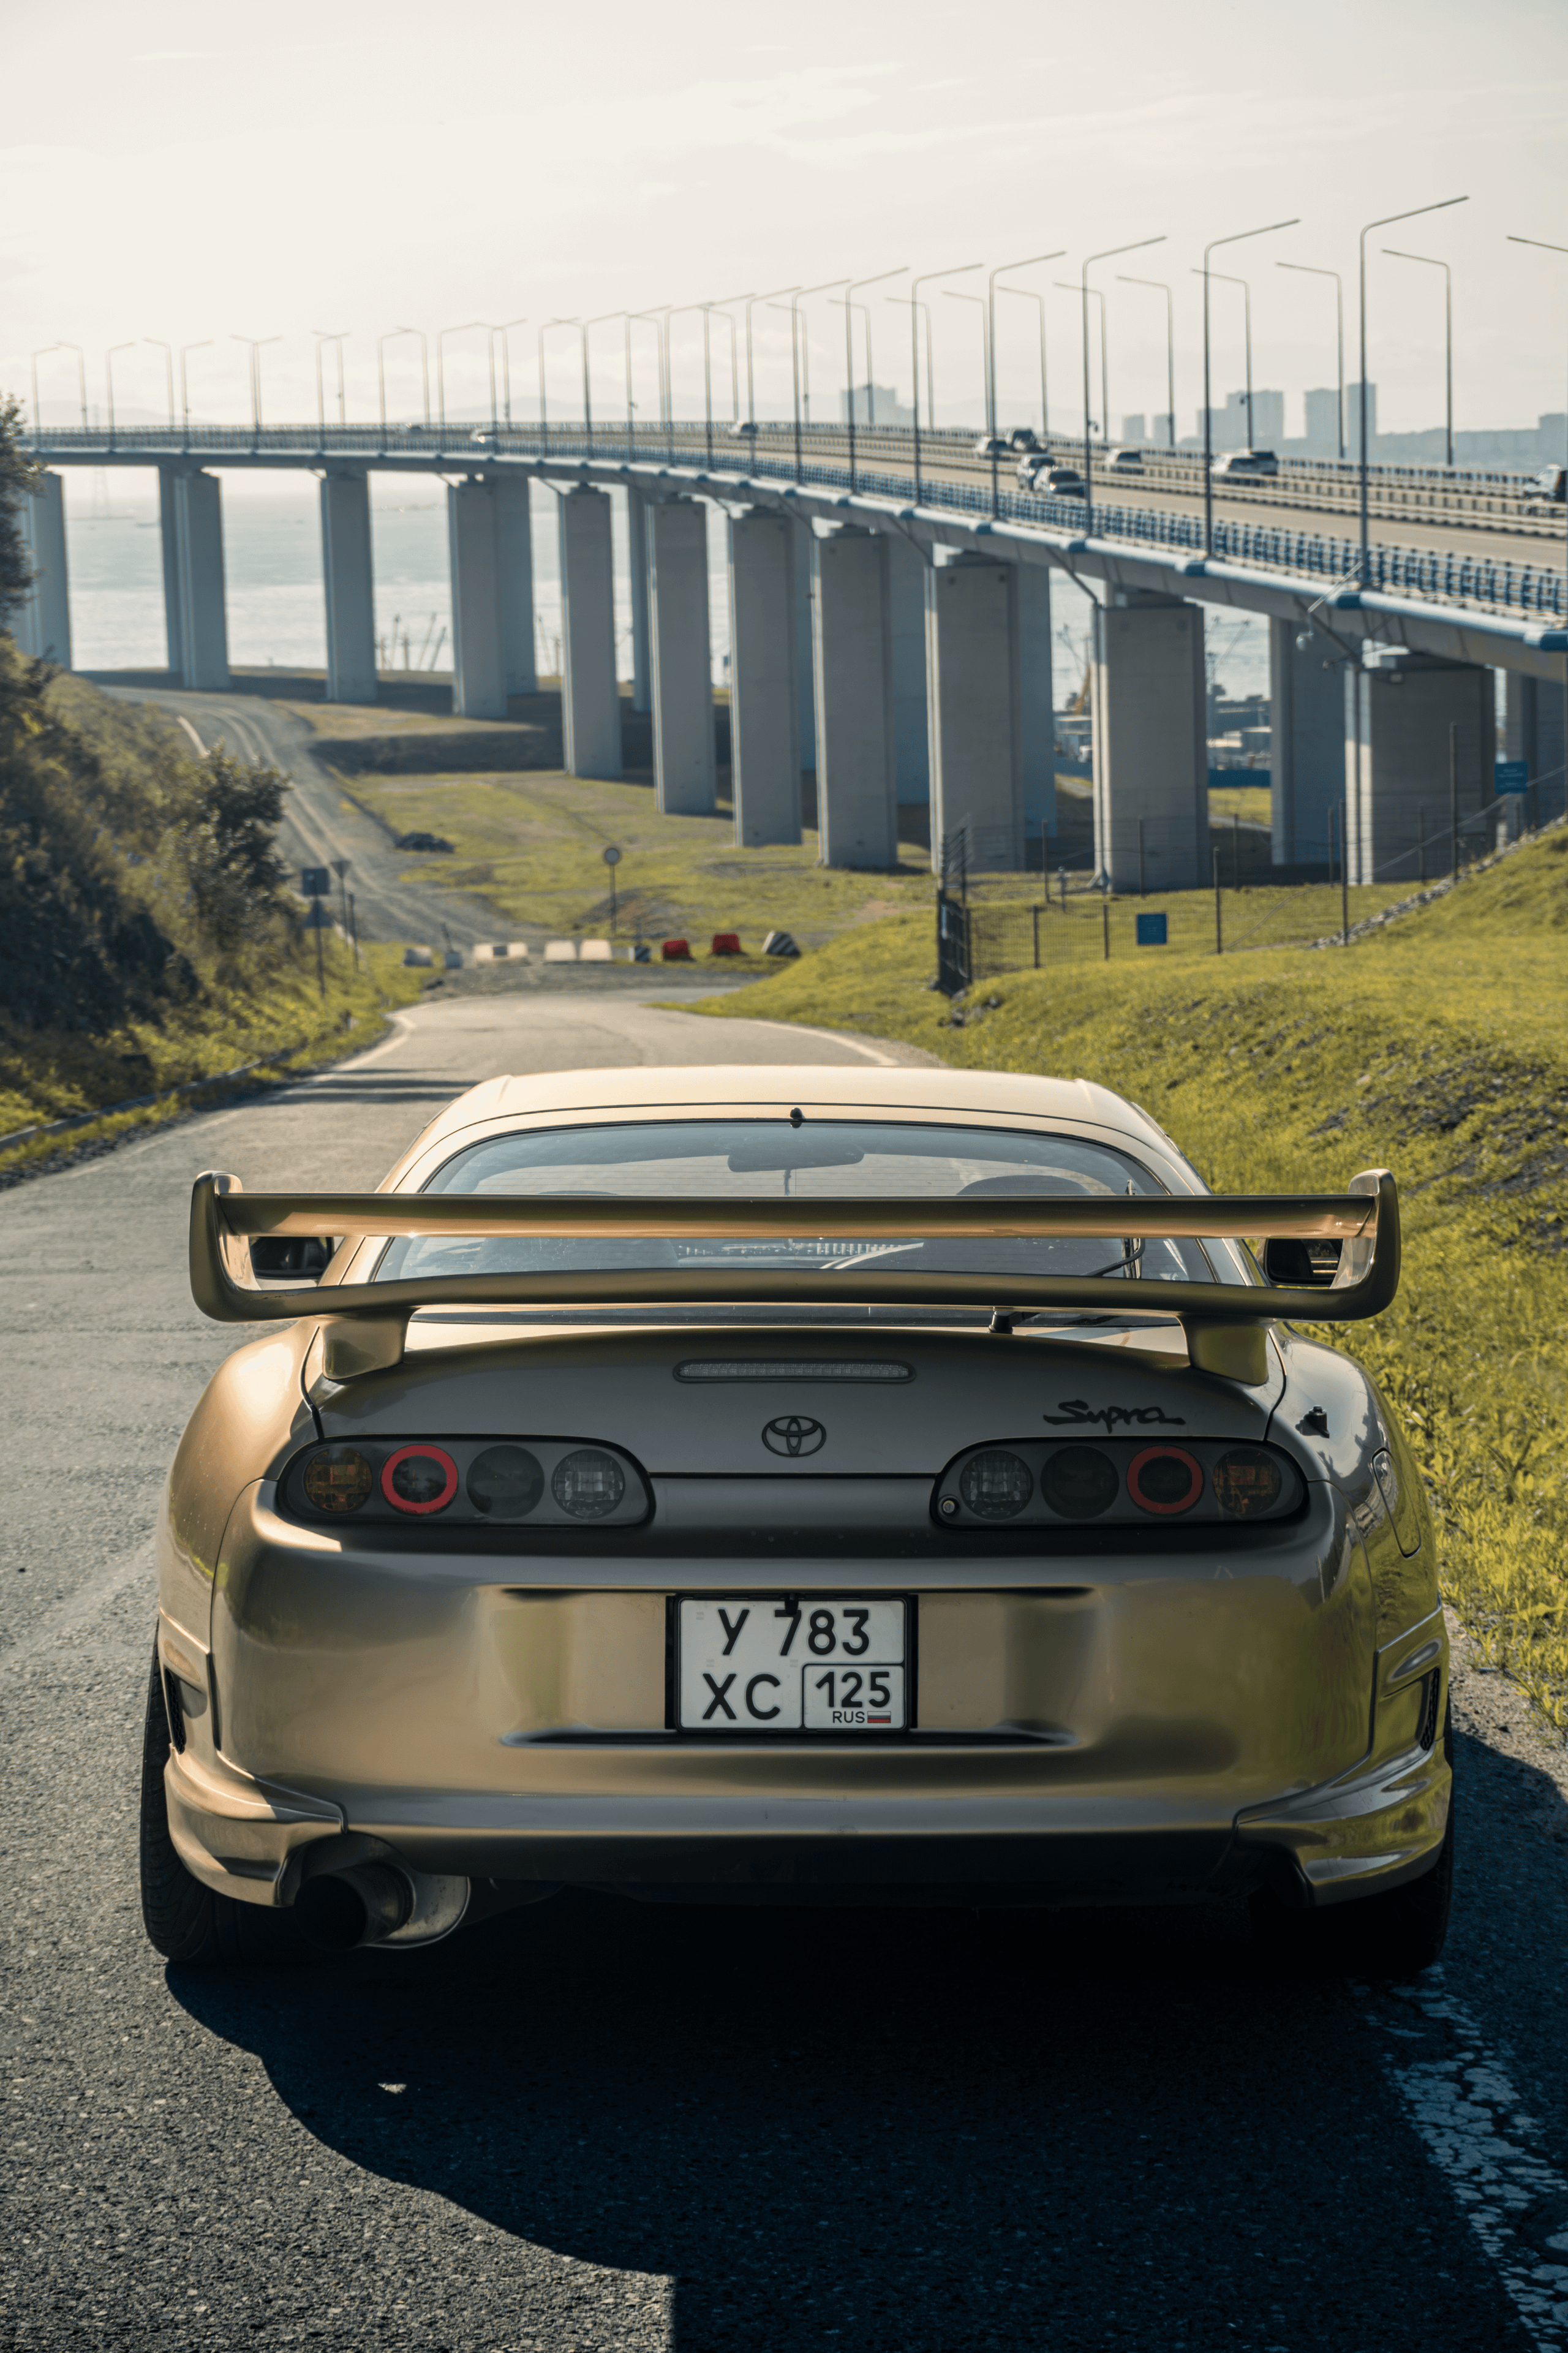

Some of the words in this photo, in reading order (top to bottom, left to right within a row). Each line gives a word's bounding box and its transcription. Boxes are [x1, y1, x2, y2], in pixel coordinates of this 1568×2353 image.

[1043, 1399, 1186, 1434] Supra
[774, 1609, 870, 1656] 783
[815, 1671, 891, 1708] 125
[832, 1711, 865, 1723] RUS
